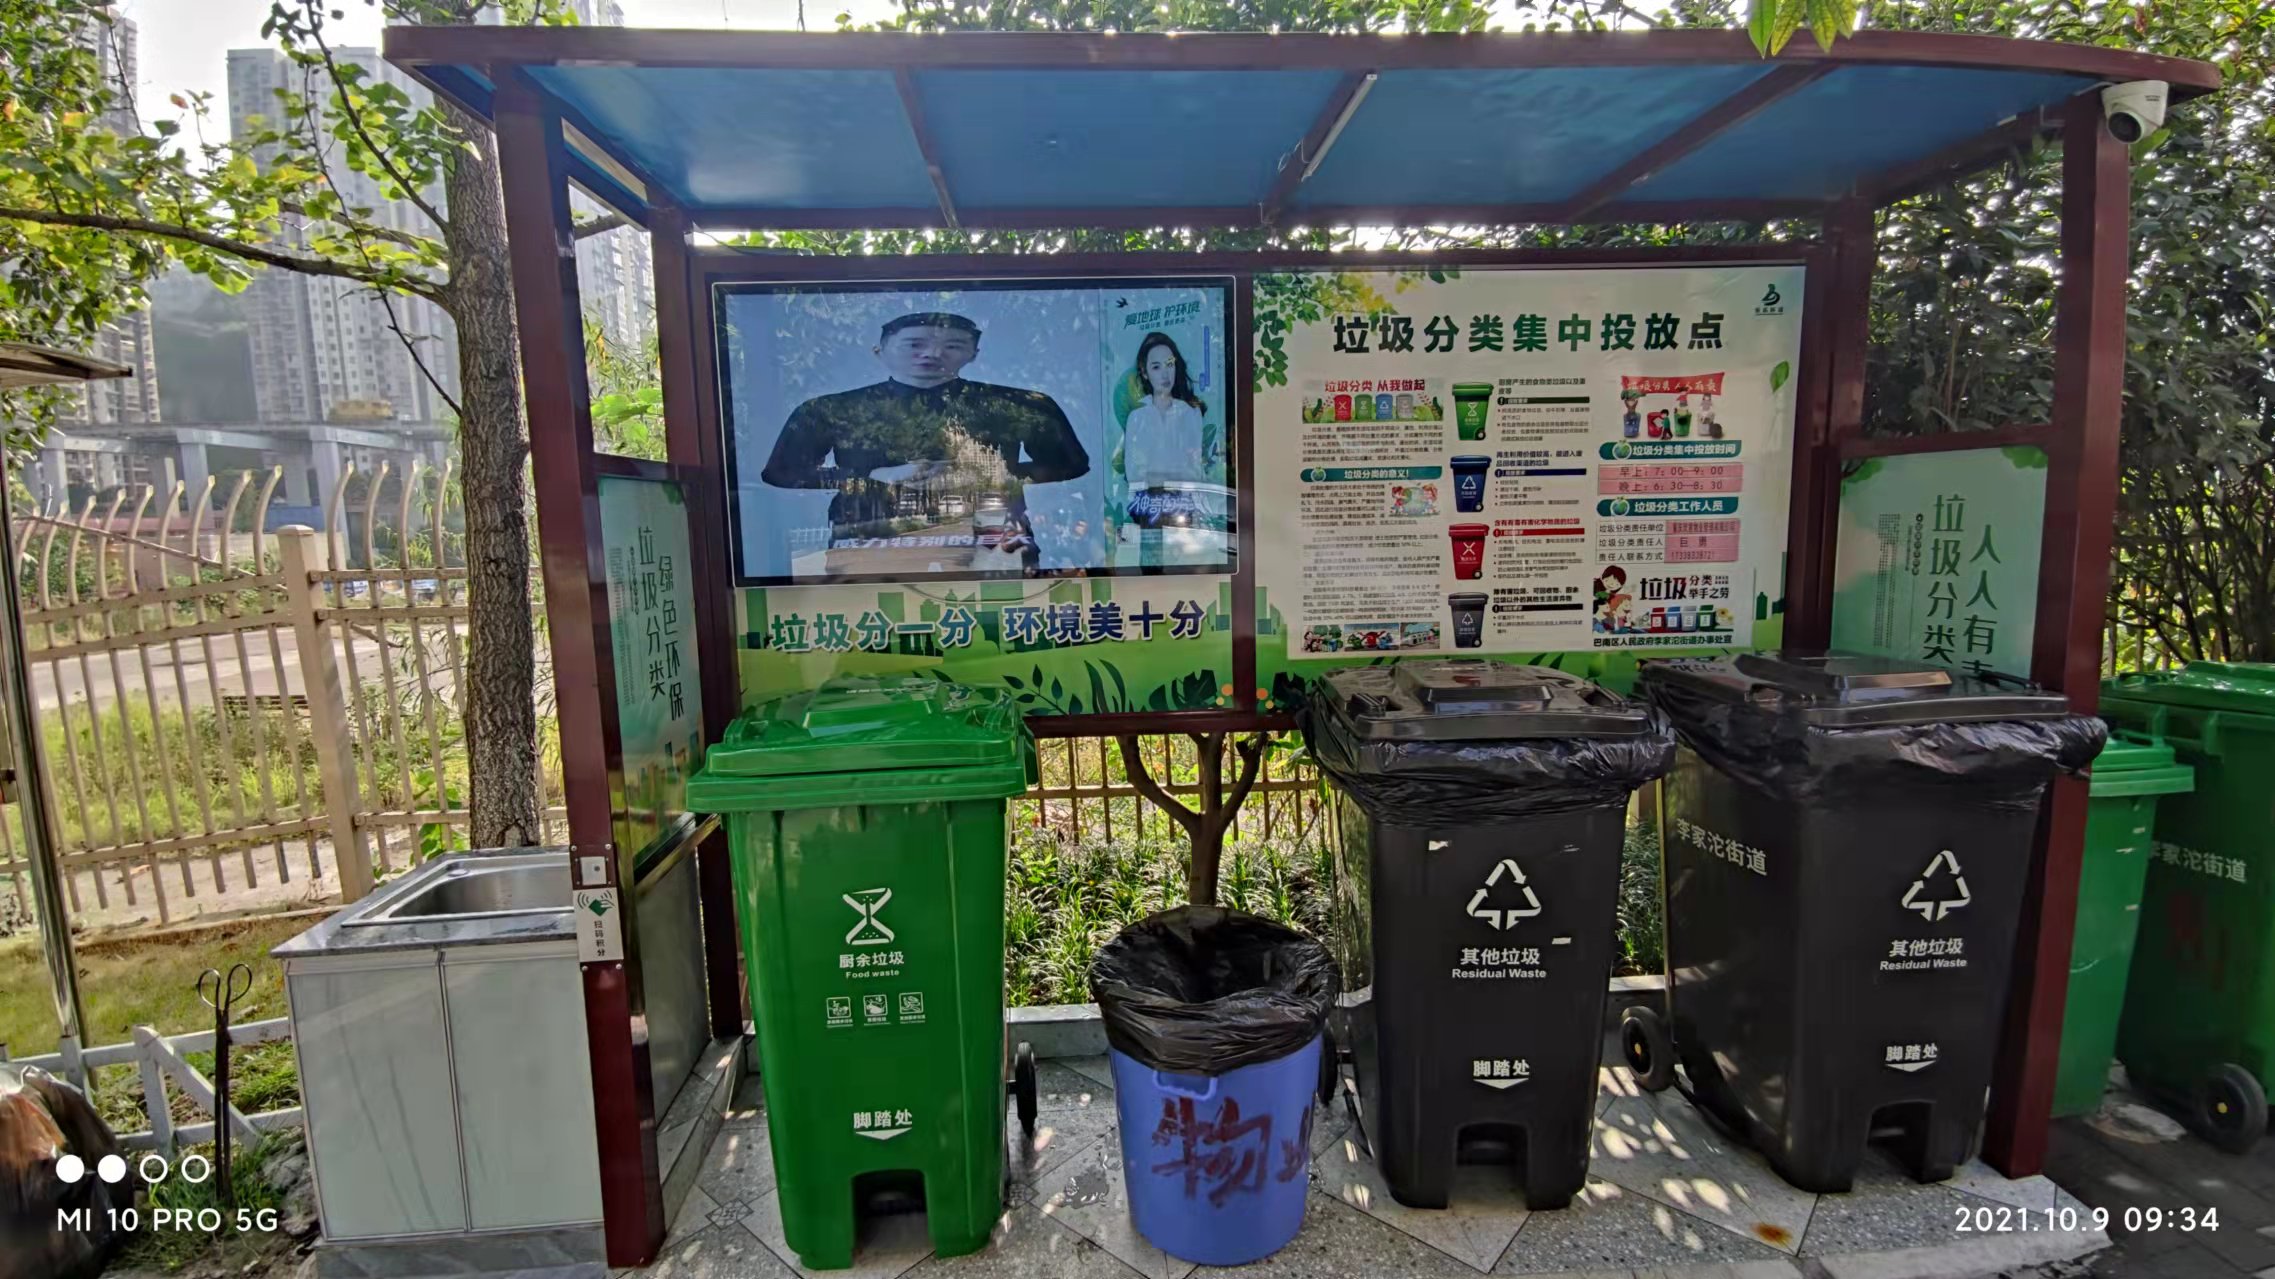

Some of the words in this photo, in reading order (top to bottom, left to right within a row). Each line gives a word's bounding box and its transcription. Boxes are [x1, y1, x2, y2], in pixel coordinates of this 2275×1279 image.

[1333, 312, 1725, 354] 垃圾分类集中投放点
[1324, 380, 1373, 393] 垃圾分类
[1377, 378, 1425, 392] 从我做起
[1632, 443, 1736, 456] 垃圾分类集中投放时间
[1634, 500, 1723, 513] 垃圾分类工作人员
[1599, 523, 1664, 533] 垃圾分类责任单位
[1599, 537, 1663, 547] 垃圾分类责任人
[1599, 552, 1663, 561] 责任人联系方式
[1689, 574, 1713, 585] 分类
[1922, 494, 1966, 664] 垃圾分类
[1640, 577, 1687, 600] 垃圾
[1688, 587, 1729, 599] 举手之劳
[638, 526, 666, 701] 垃圾分类
[770, 606, 977, 652] 垃圾分一分
[1002, 599, 1206, 643] 环境美十分
[659, 555, 685, 721] 绿色环保
[1677, 818, 1767, 876] 李家沱街道
[1889, 938, 1963, 957] 其他垃圾
[839, 951, 904, 968] 厨余垃圾
[1460, 948, 1540, 965] 其他垃圾
[1880, 959, 1930, 971] Residual
[1933, 958, 1967, 968] Waste
[846, 971, 870, 979] Food
[872, 969, 899, 977] waste
[1452, 968, 1506, 978] Residual
[1509, 968, 1547, 978] Waste
[1885, 1042, 1938, 1062] 脚踏处
[1473, 1059, 1530, 1077] 脚踏处
[853, 1108, 912, 1128] 脚踏处
